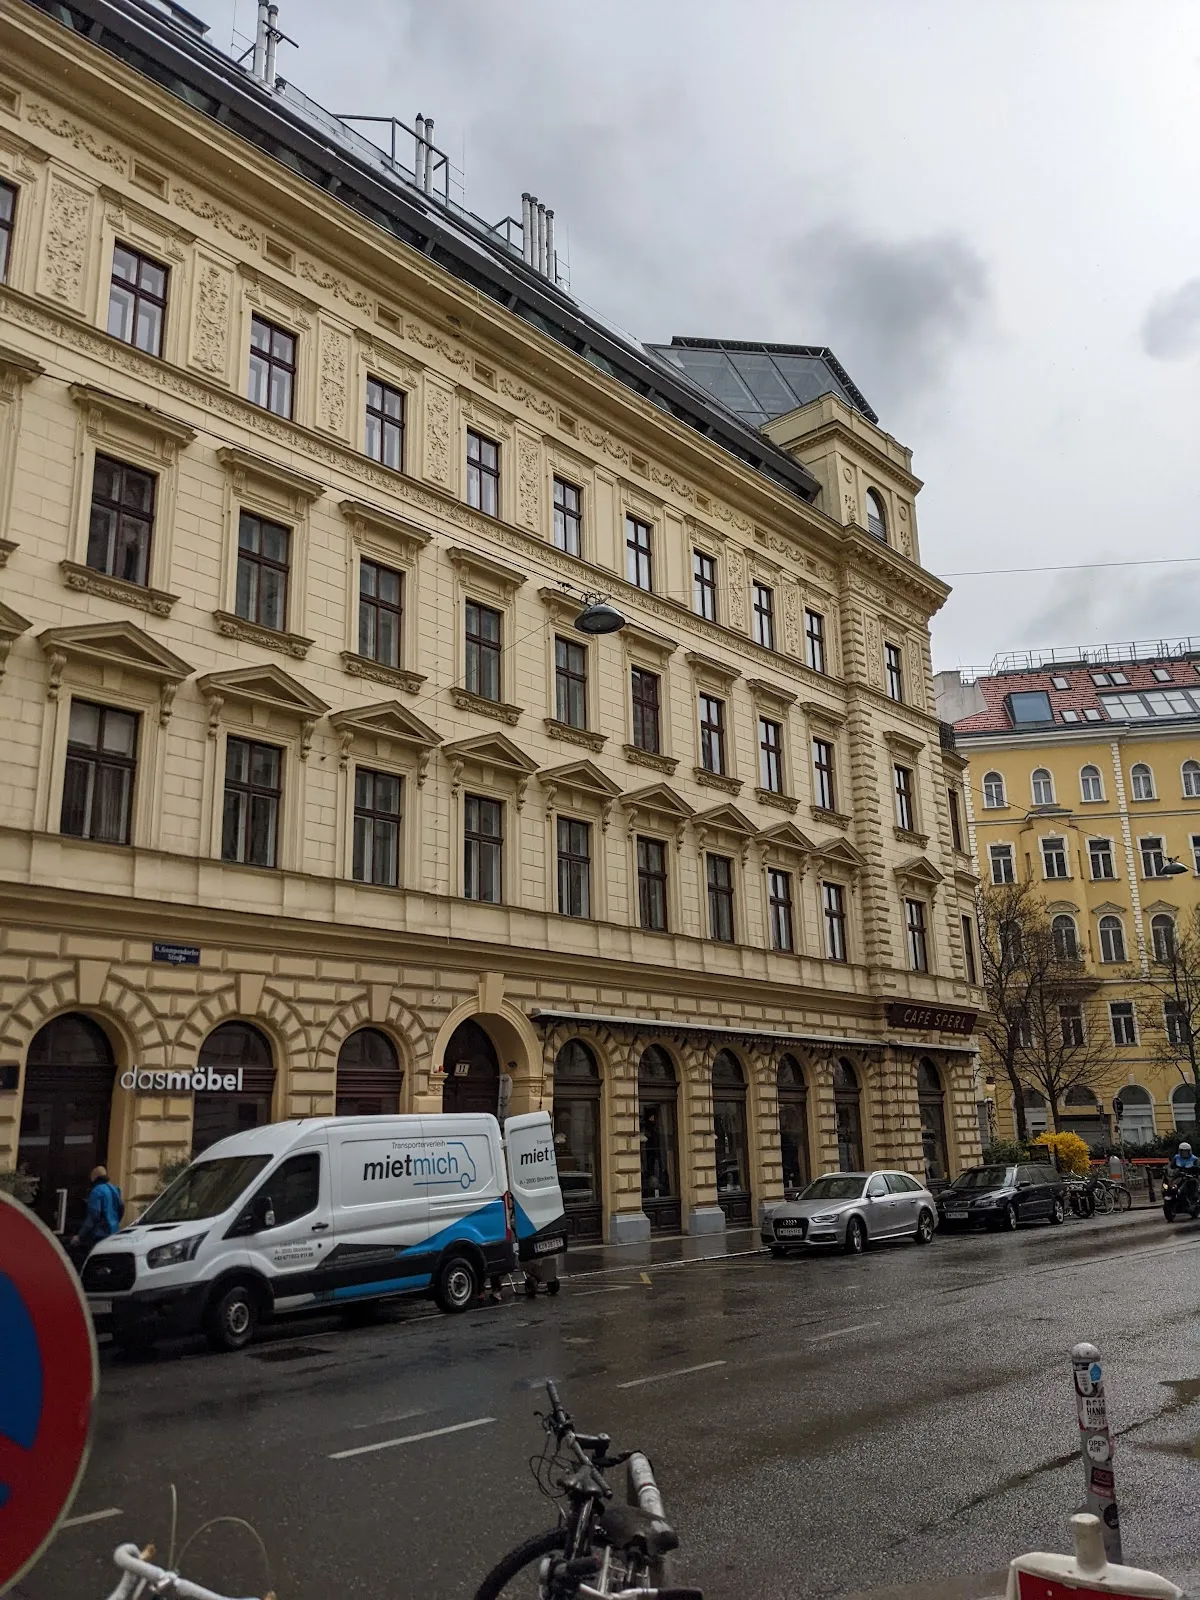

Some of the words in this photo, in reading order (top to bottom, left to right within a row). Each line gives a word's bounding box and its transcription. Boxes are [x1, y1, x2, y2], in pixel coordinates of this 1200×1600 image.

[934, 1013, 966, 1029] SPERL
[120, 1064, 243, 1091] dasmöbel
[392, 1140, 446, 1150] Transporterverleih
[363, 1152, 459, 1181] mietmich
